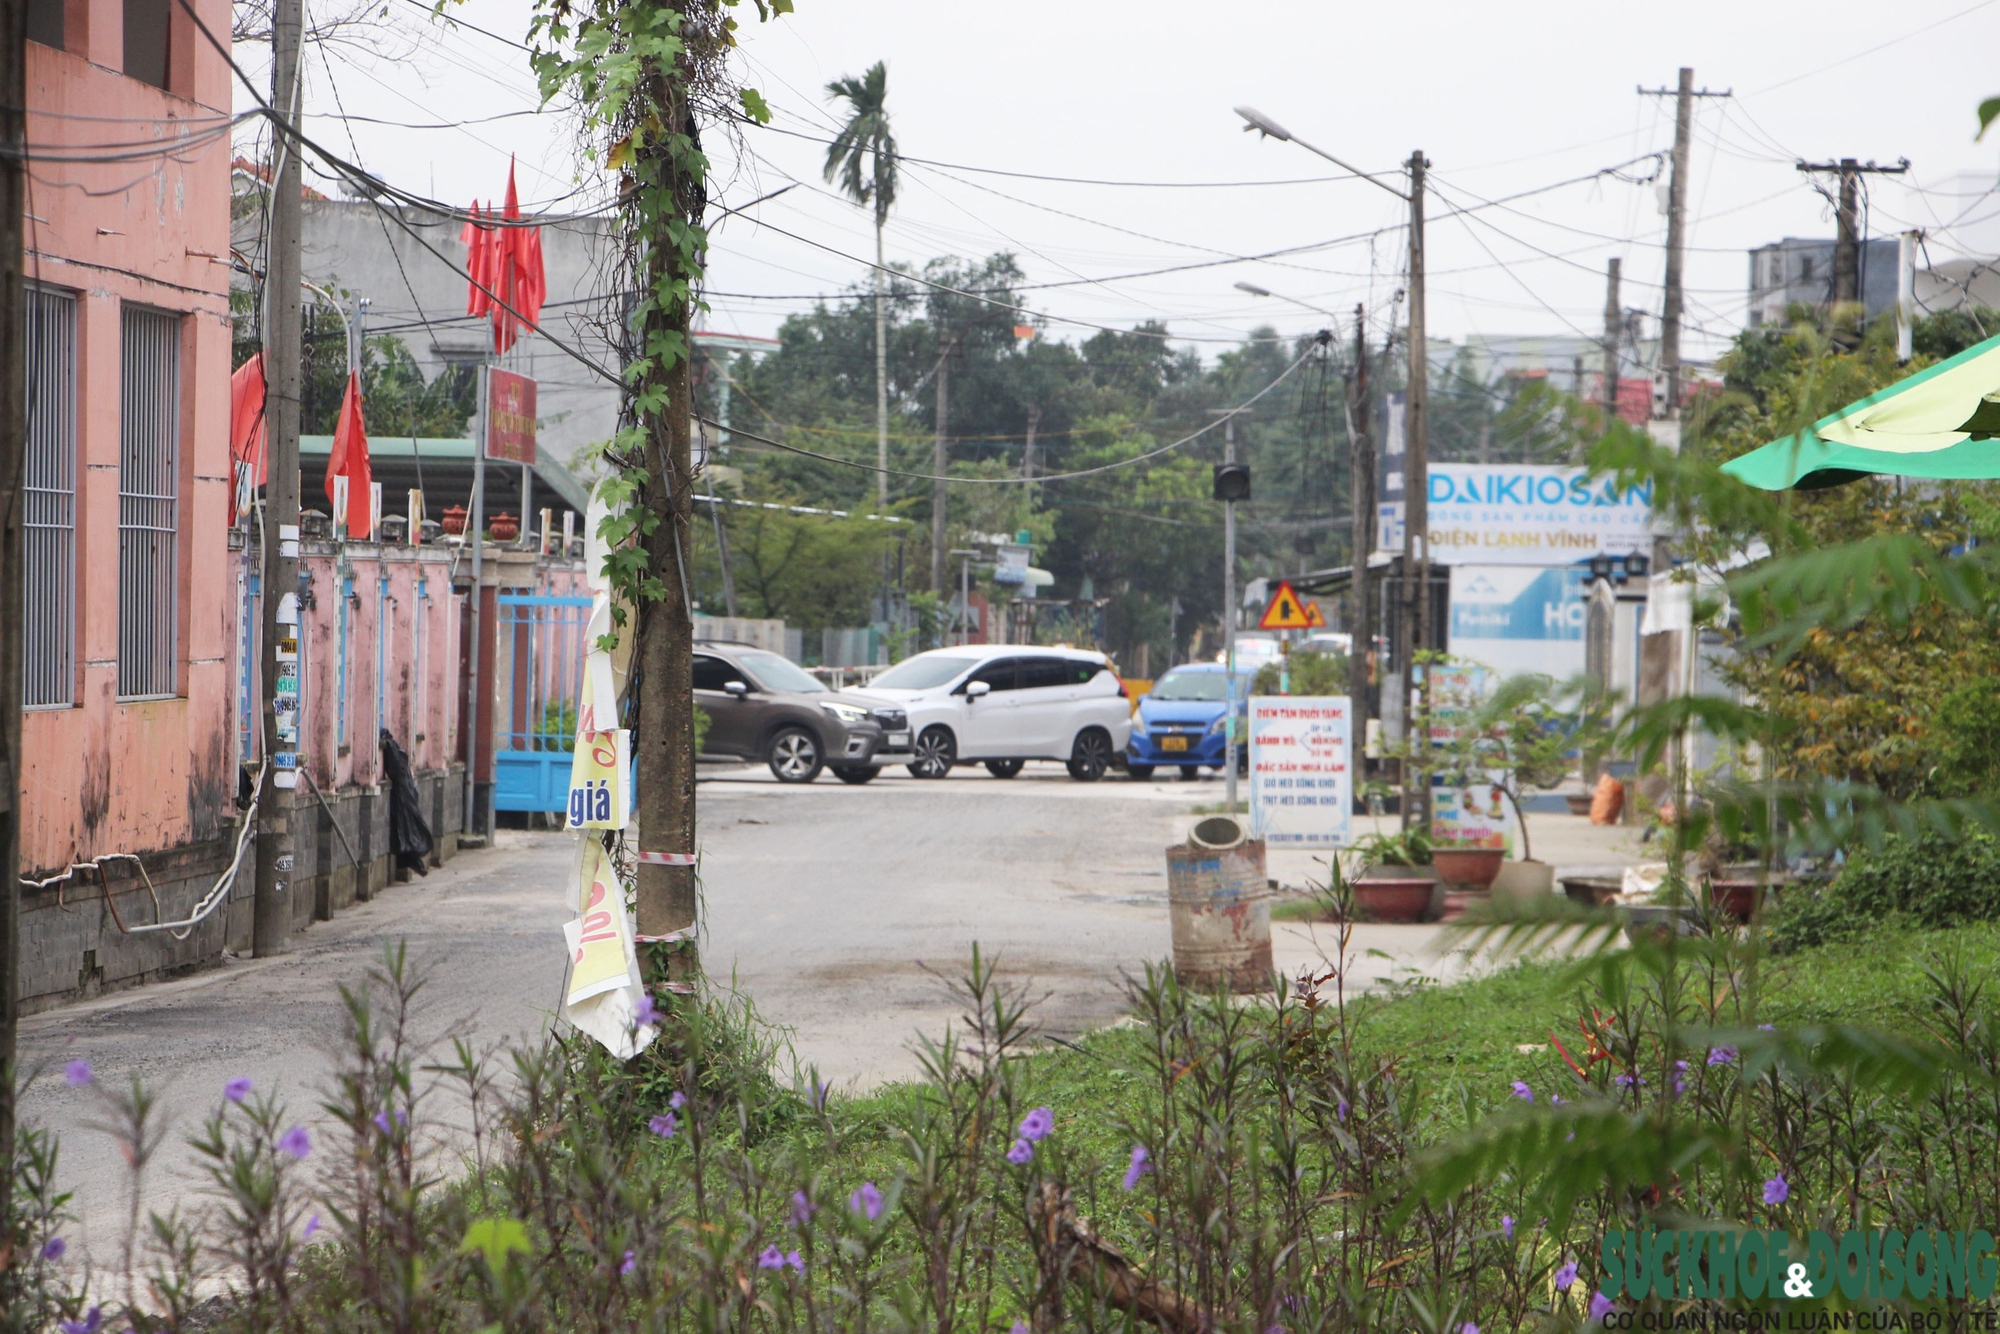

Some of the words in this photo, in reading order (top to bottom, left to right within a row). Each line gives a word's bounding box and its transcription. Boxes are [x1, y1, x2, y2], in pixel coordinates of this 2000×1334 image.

[1428, 473, 1652, 507] DAIKIOSAN
[1428, 527, 1478, 550] ĐIỆN
[1484, 531, 1541, 551] LẠNH
[1546, 528, 1598, 549] VĨNH
[570, 780, 611, 827] giá
